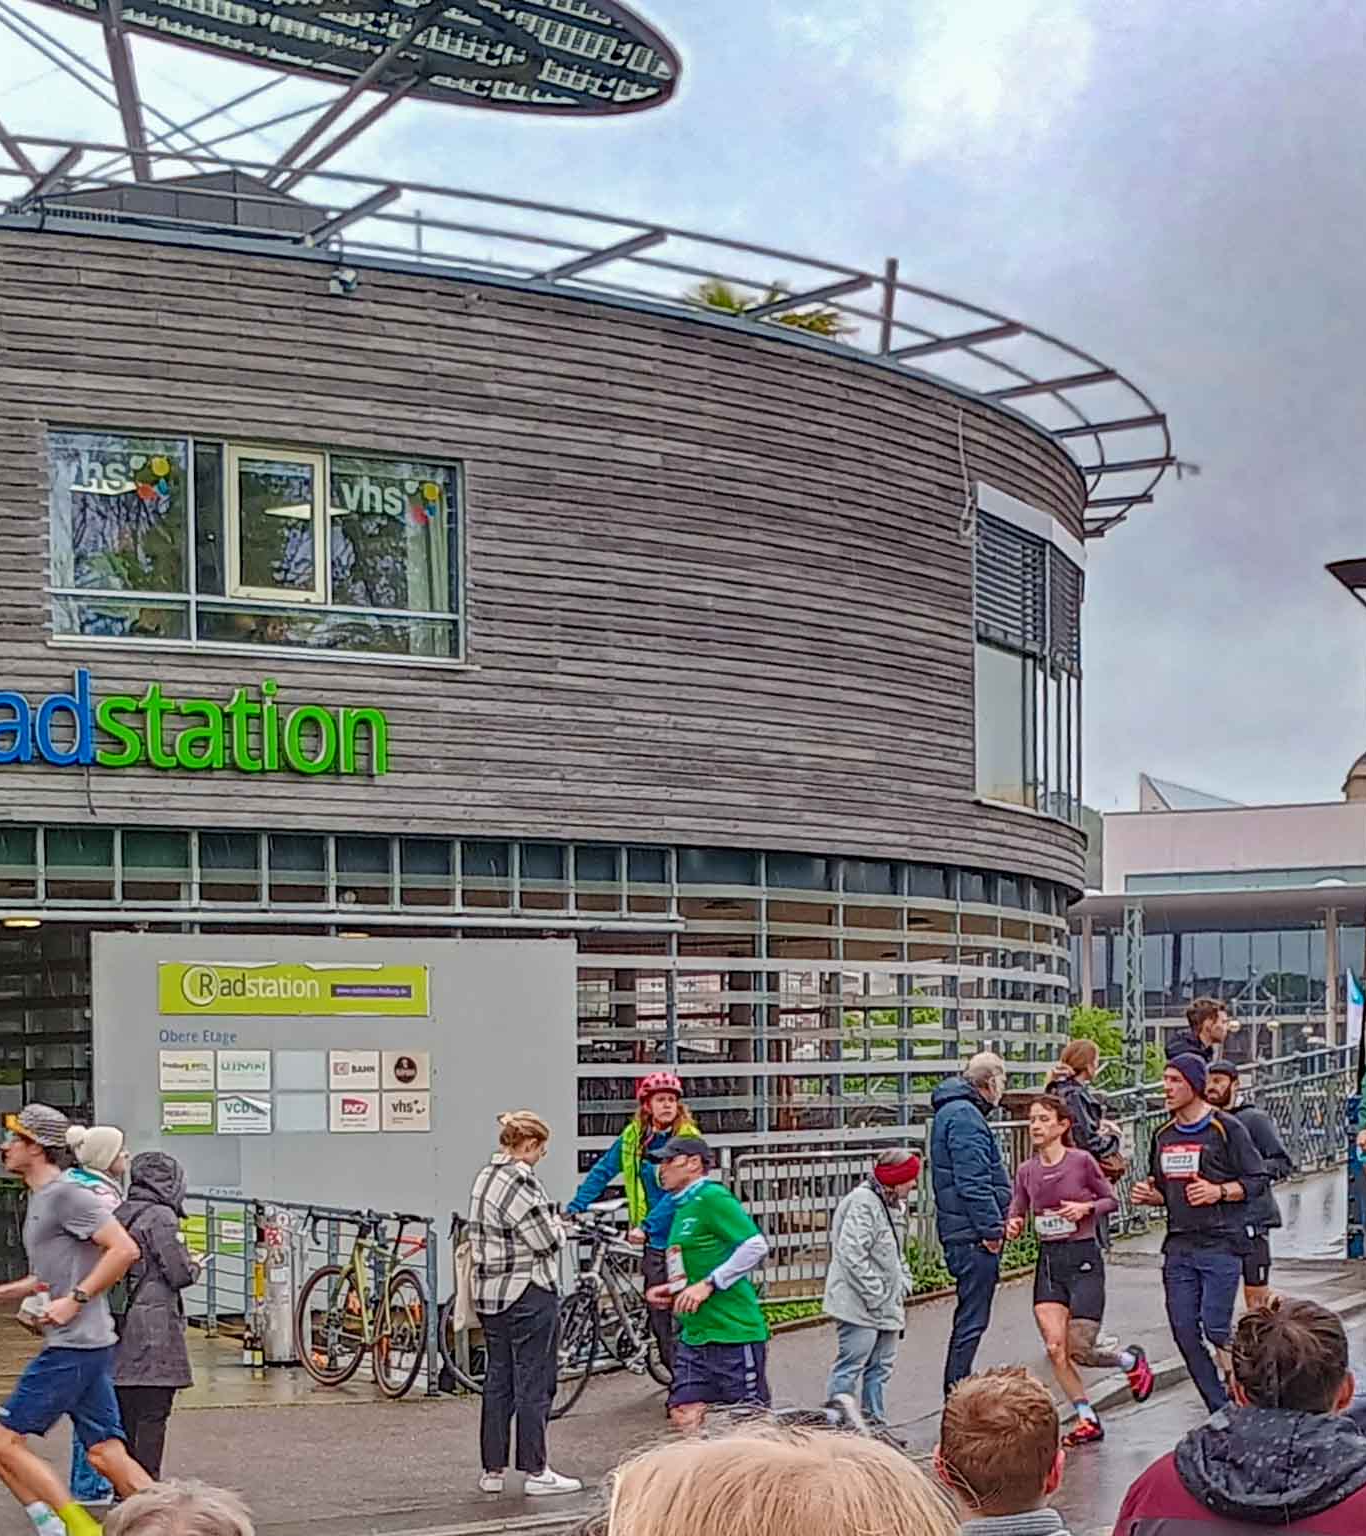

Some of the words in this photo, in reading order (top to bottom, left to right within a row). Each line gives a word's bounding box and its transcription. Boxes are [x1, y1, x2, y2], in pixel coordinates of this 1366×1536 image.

[340, 476, 403, 516] vhs
[198, 972, 320, 998] Radstation
[159, 1029, 198, 1042] Obere
[203, 1029, 238, 1046] Etage
[391, 1099, 414, 1113] vhs
